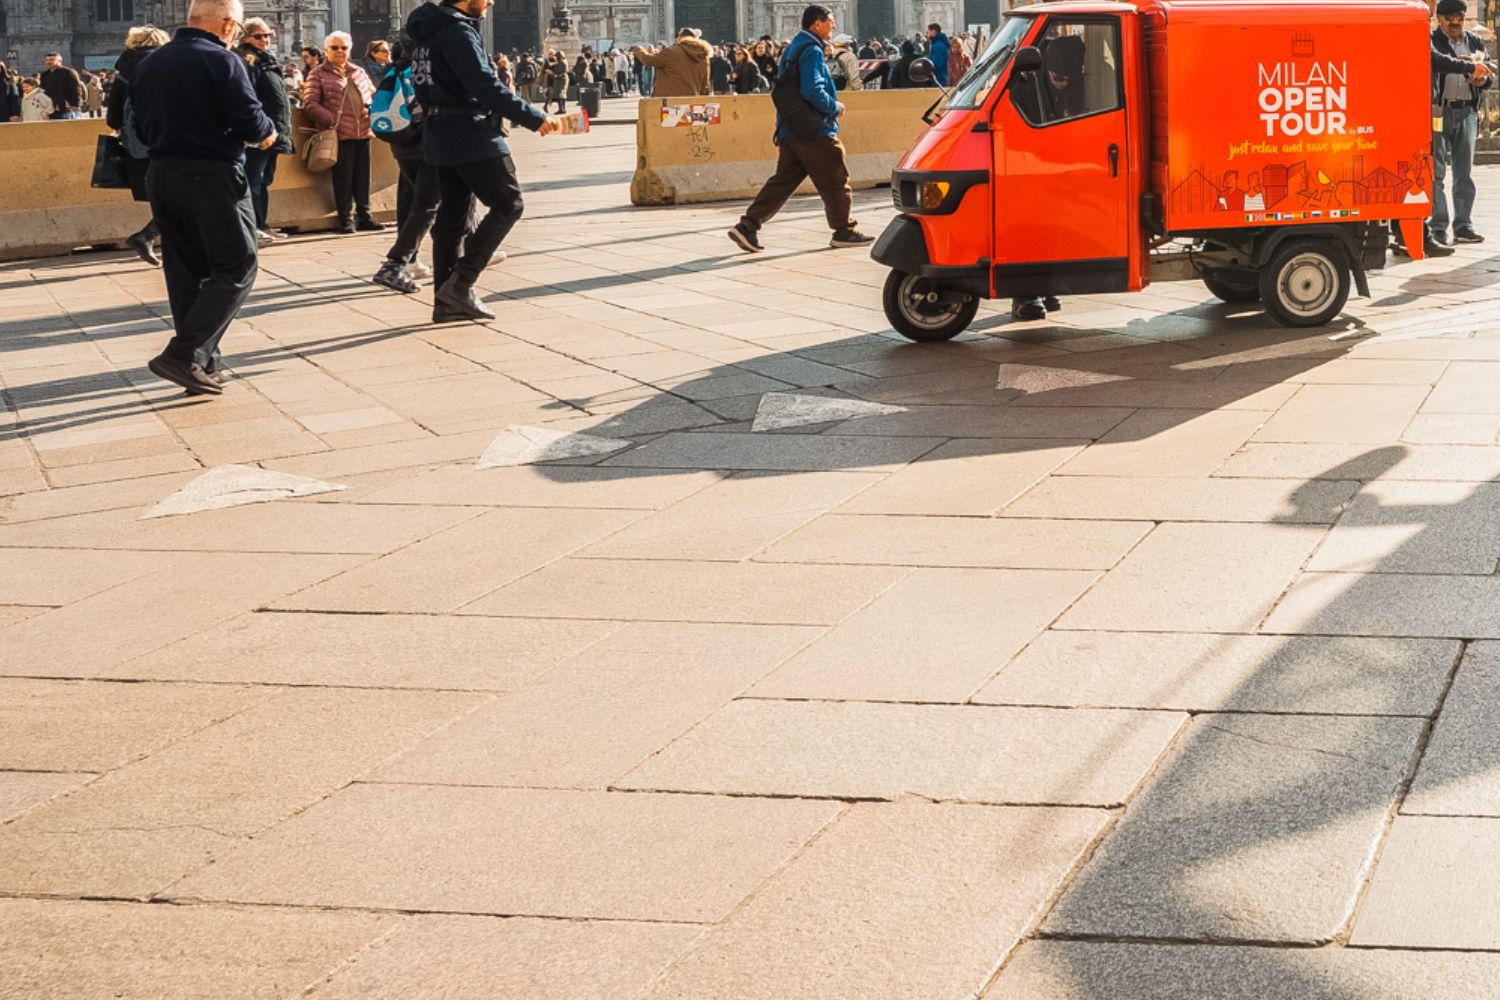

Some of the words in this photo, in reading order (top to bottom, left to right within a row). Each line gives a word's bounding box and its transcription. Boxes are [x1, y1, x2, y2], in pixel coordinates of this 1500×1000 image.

[1258, 60, 1347, 87] MILAN
[1258, 86, 1347, 113] OPEN
[1260, 111, 1347, 136] TOUR
[1227, 140, 1251, 160] just
[1252, 141, 1279, 153] relax
[1282, 139, 1303, 153] and
[1306, 142, 1328, 153] save
[1331, 140, 1354, 154] your
[1355, 137, 1378, 151] time
